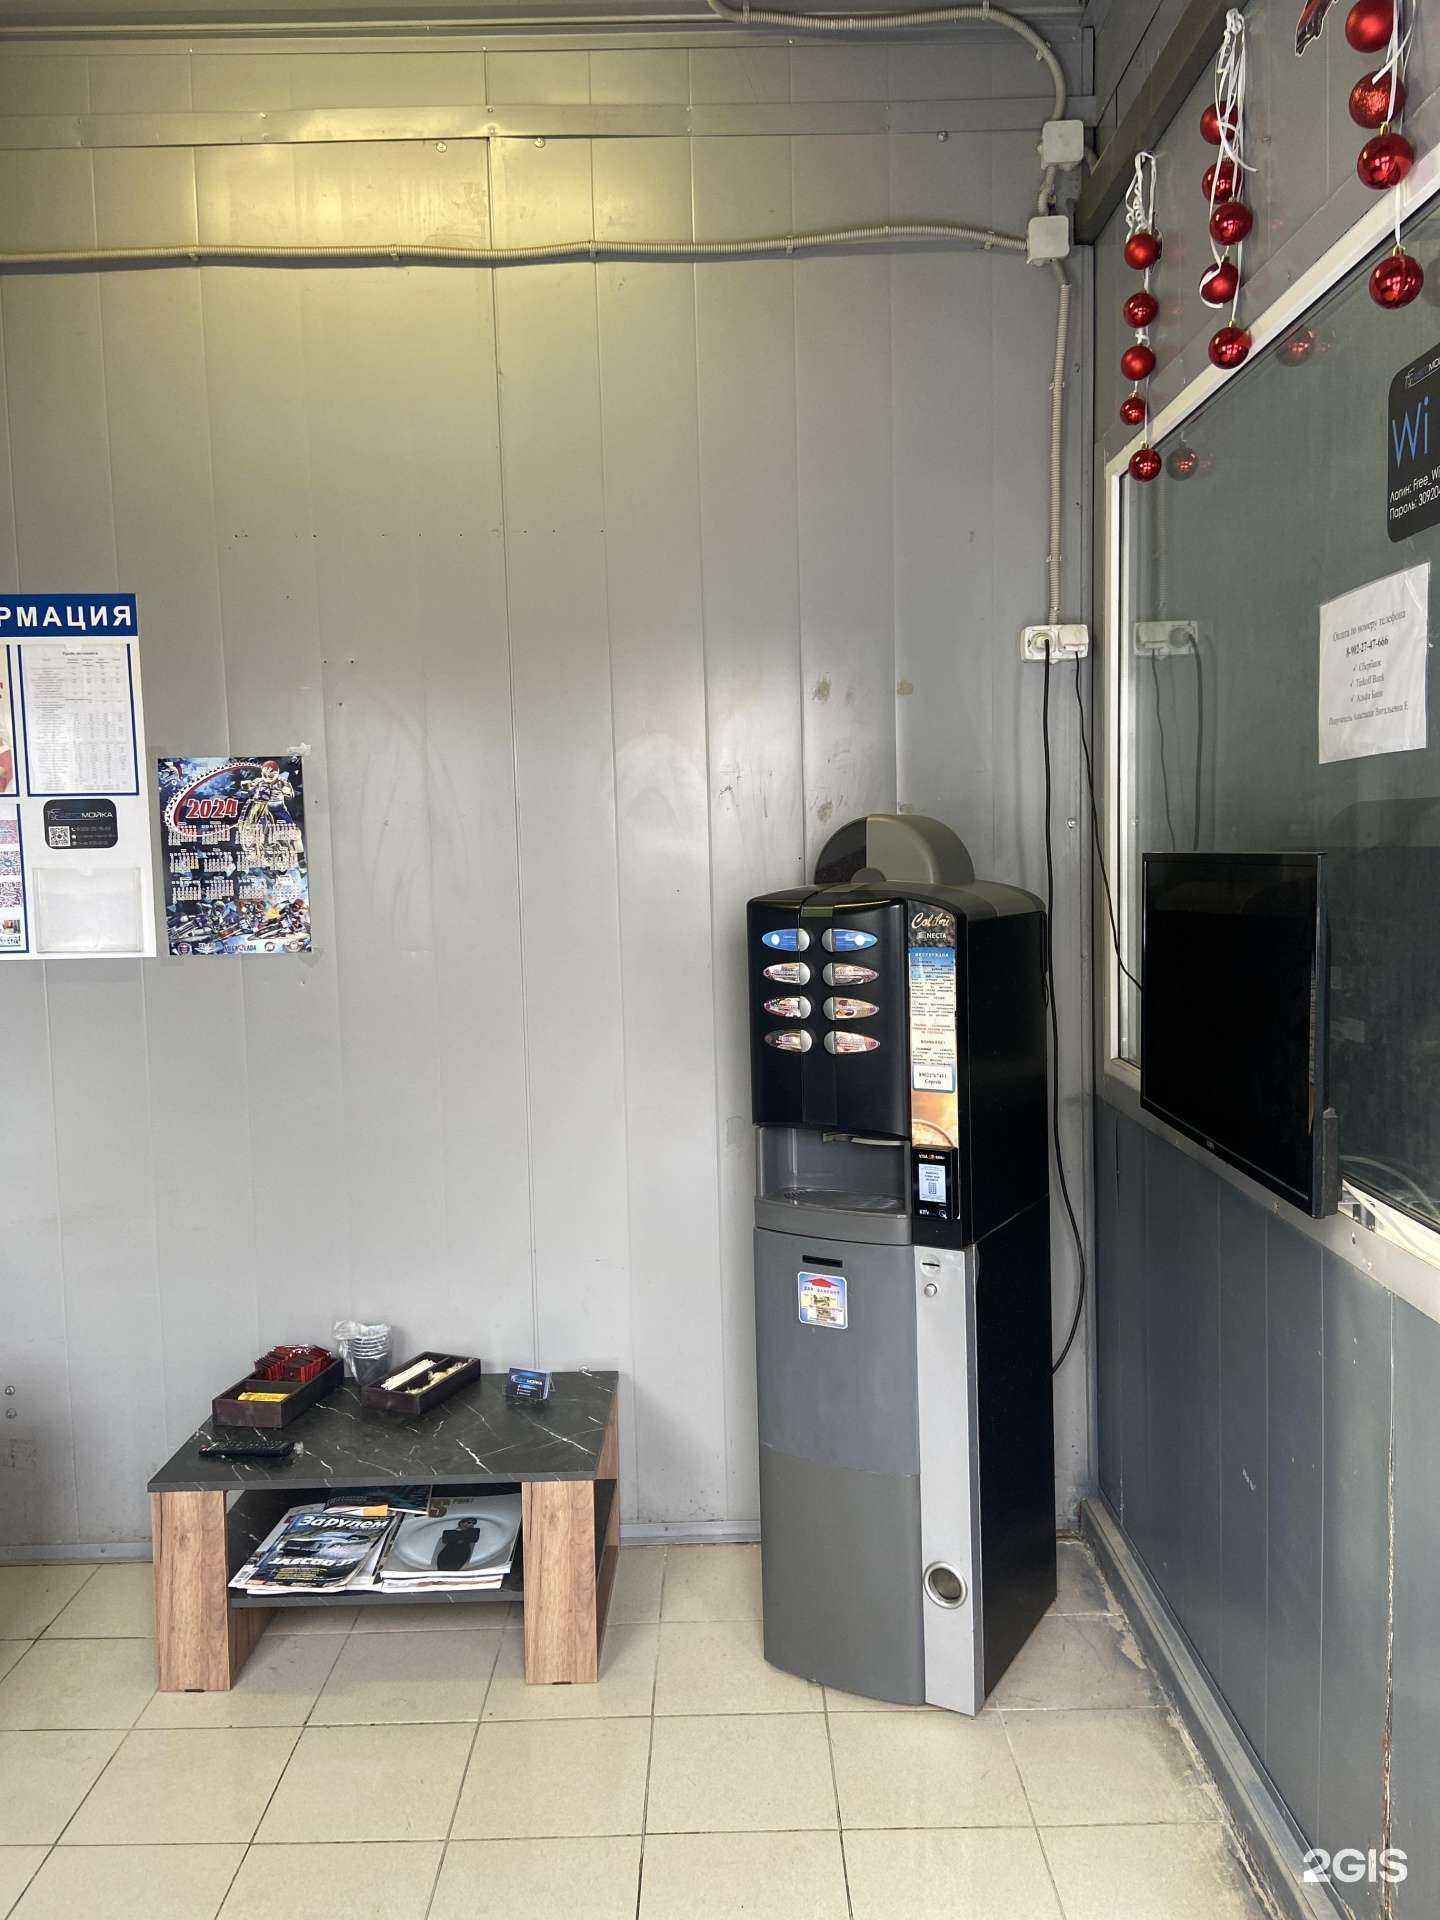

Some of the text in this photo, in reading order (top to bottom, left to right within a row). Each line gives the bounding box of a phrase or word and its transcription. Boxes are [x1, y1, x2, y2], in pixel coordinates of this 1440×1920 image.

[1389, 484, 1412, 503] Логин:
[1389, 499, 1417, 520] Пароль:
[1379, 610, 1406, 627] телефона
[186, 798, 239, 819] 2024
